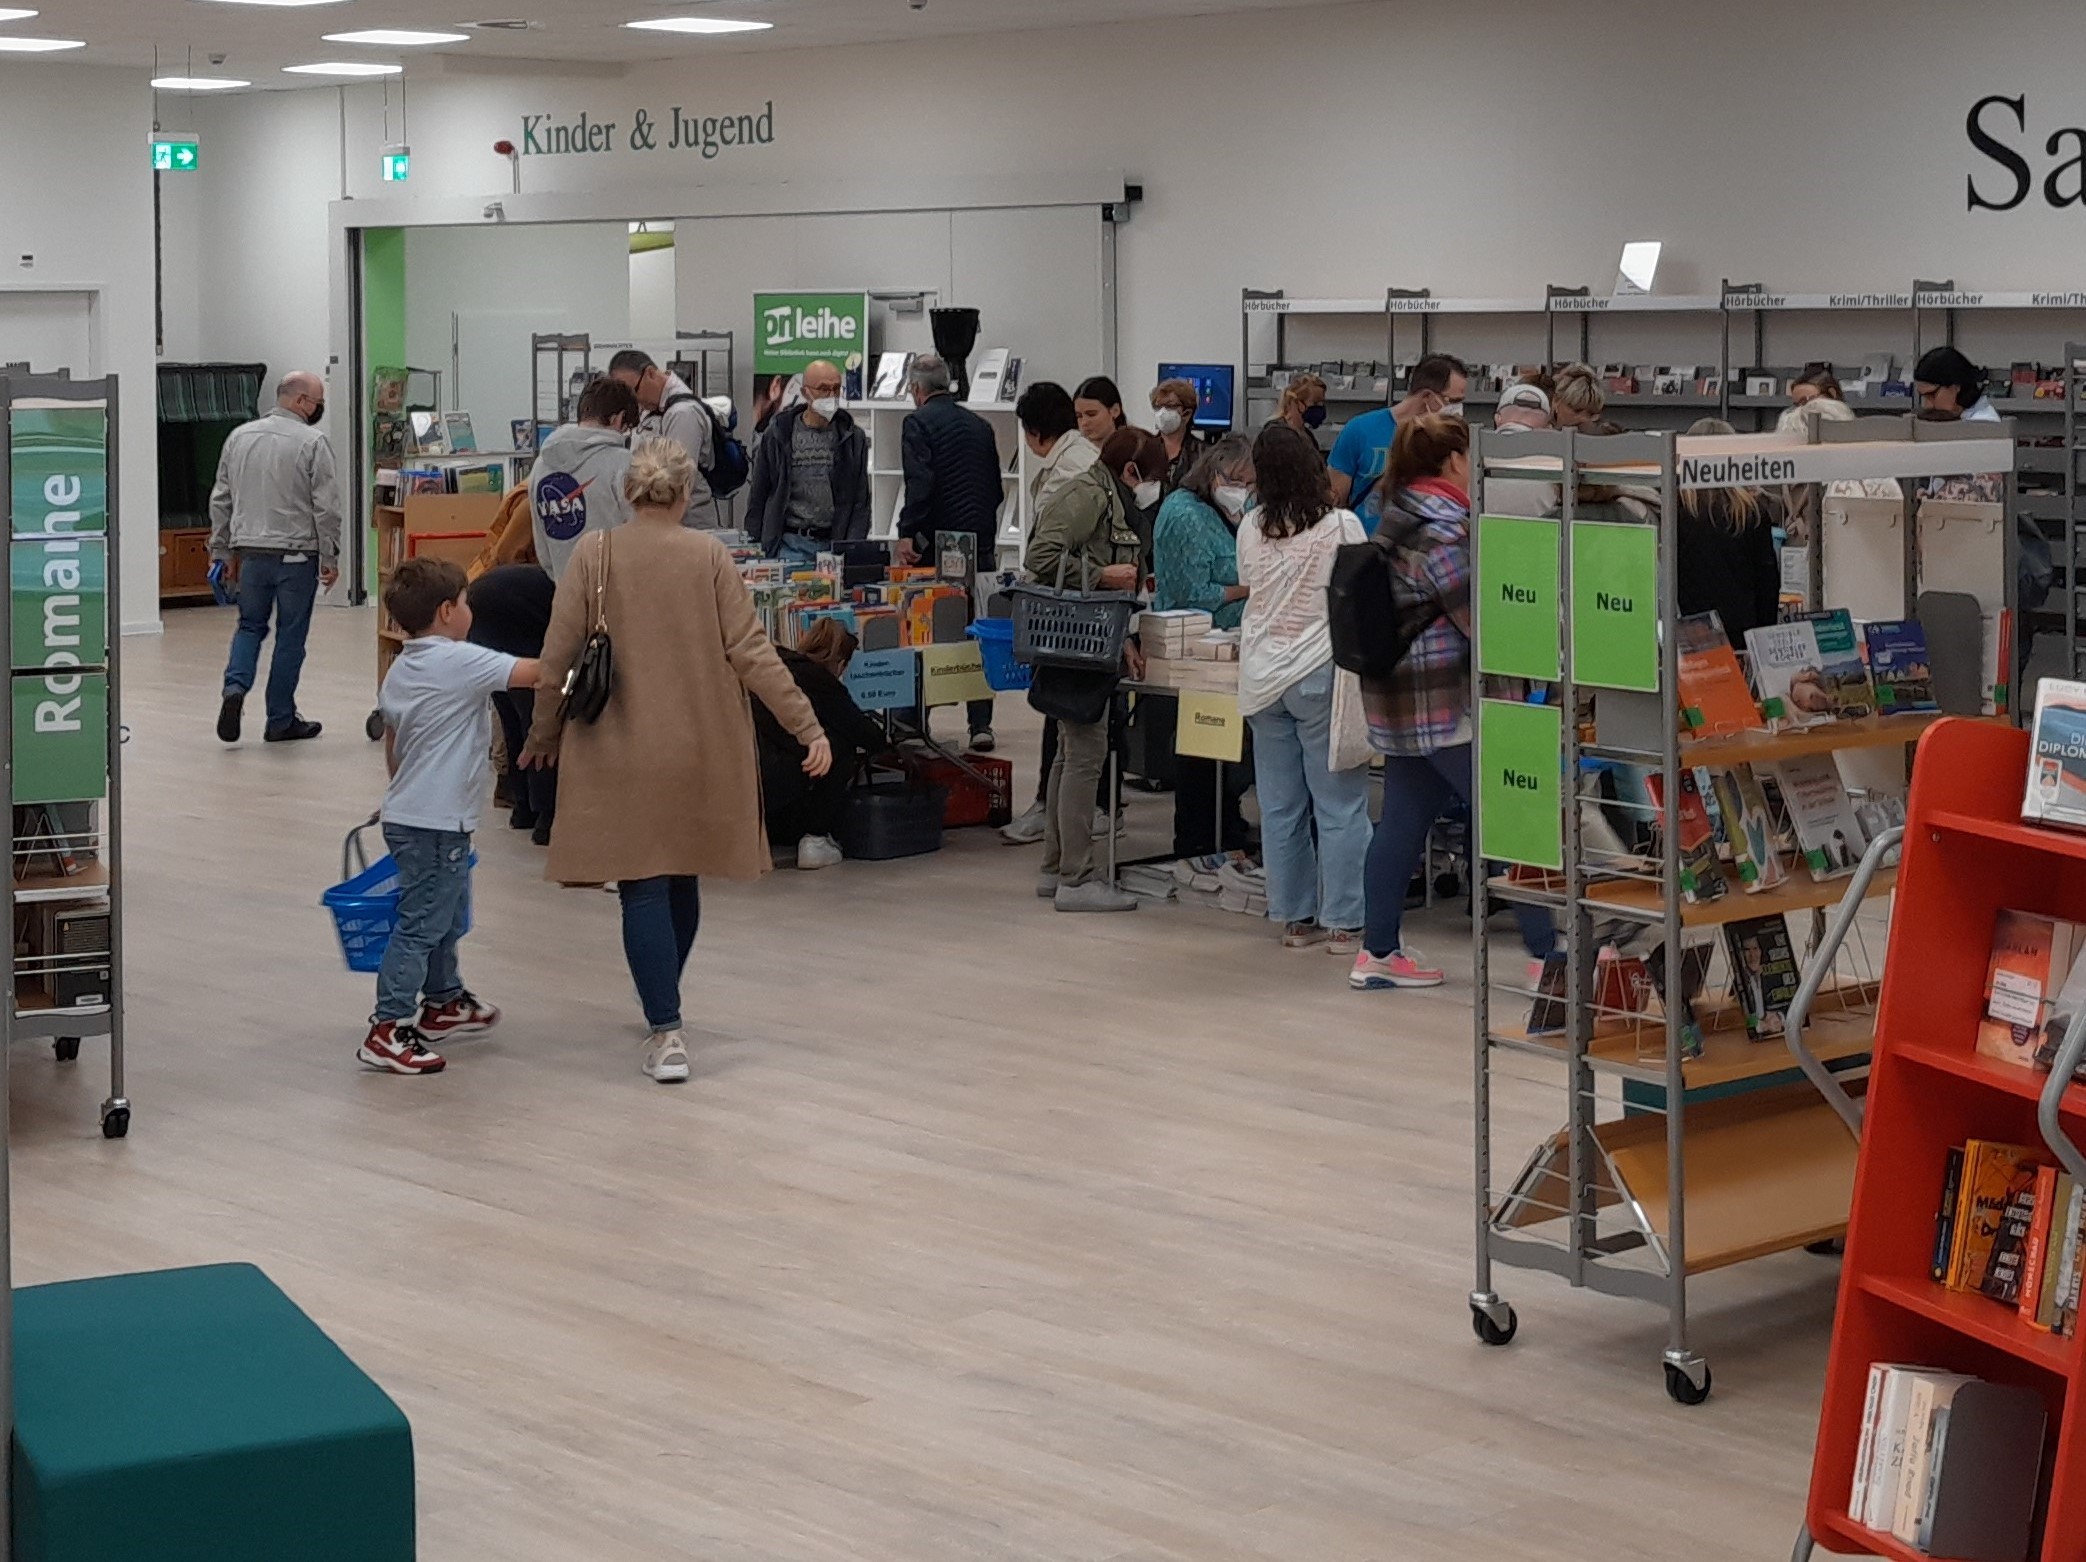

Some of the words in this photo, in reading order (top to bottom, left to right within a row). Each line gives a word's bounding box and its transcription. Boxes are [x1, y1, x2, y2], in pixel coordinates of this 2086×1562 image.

[521, 111, 616, 155] Kinder
[630, 108, 656, 151] &
[668, 100, 775, 159] Jugend
[1244, 301, 1290, 311] Hörbücher
[1390, 301, 1441, 311] Hörbücher
[1554, 298, 1610, 310] Hörbücher
[1726, 295, 1786, 307] Hörbücher
[1829, 295, 1909, 307] Krimi/Thriller
[1917, 293, 1984, 306] Hörbücher
[1682, 454, 1795, 484] Neuheiten
[537, 496, 584, 517] NASA
[34, 473, 82, 733] Romane
[1502, 583, 1536, 603] Neu
[1597, 592, 1633, 612] Neu
[1503, 768, 1538, 790] Neu
